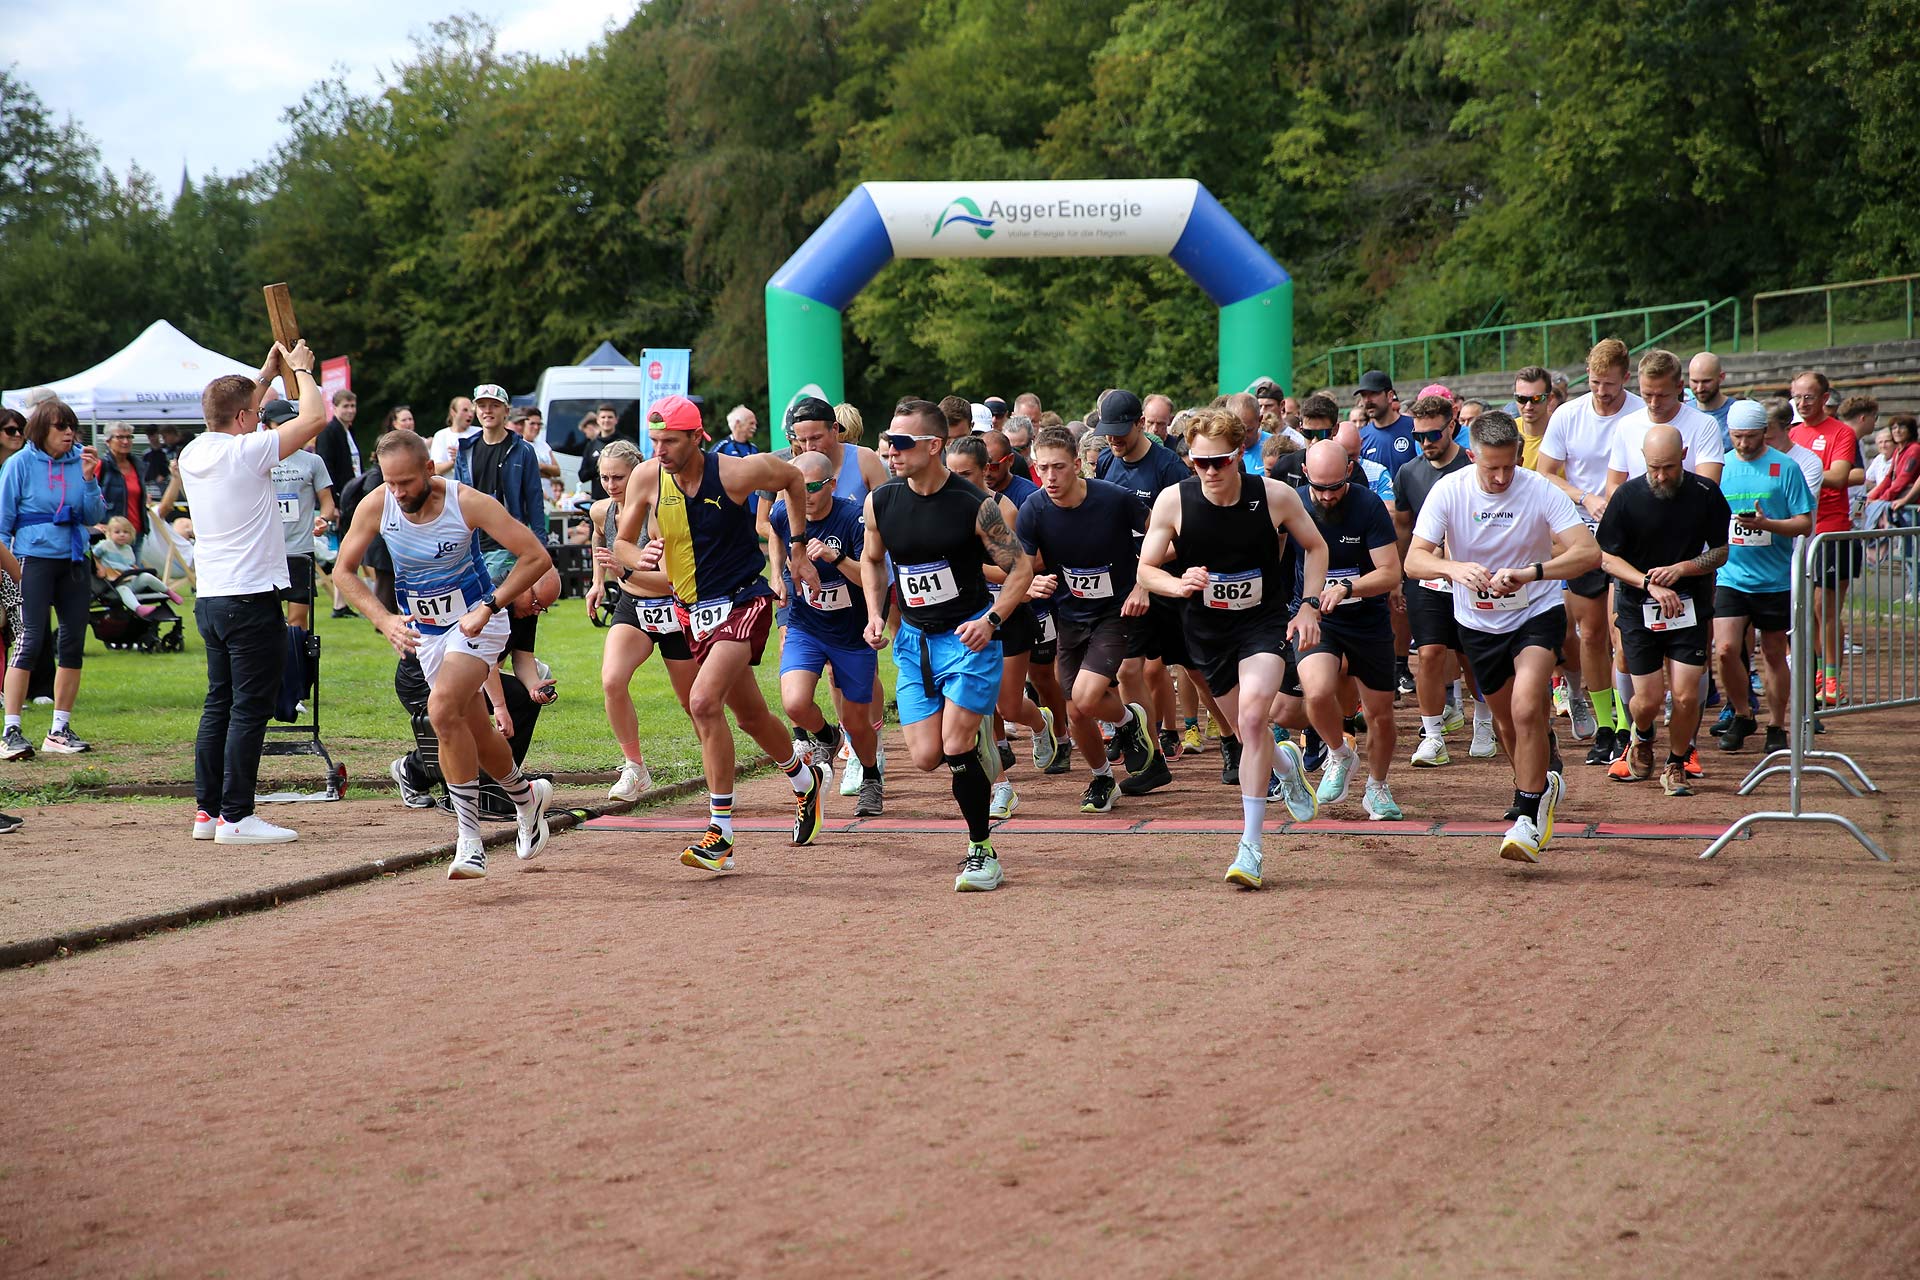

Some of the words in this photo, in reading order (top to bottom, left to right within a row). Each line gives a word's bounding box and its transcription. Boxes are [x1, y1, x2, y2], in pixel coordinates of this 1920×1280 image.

[988, 199, 1142, 222] AggerEnergie
[136, 392, 160, 402] BSV
[165, 391, 201, 401] Viktori
[907, 572, 942, 595] 641
[1068, 575, 1101, 590] 727
[1213, 581, 1252, 600] 862
[812, 589, 838, 602] 77
[416, 595, 452, 616] 617
[643, 607, 673, 624] 621
[695, 607, 722, 629] 791
